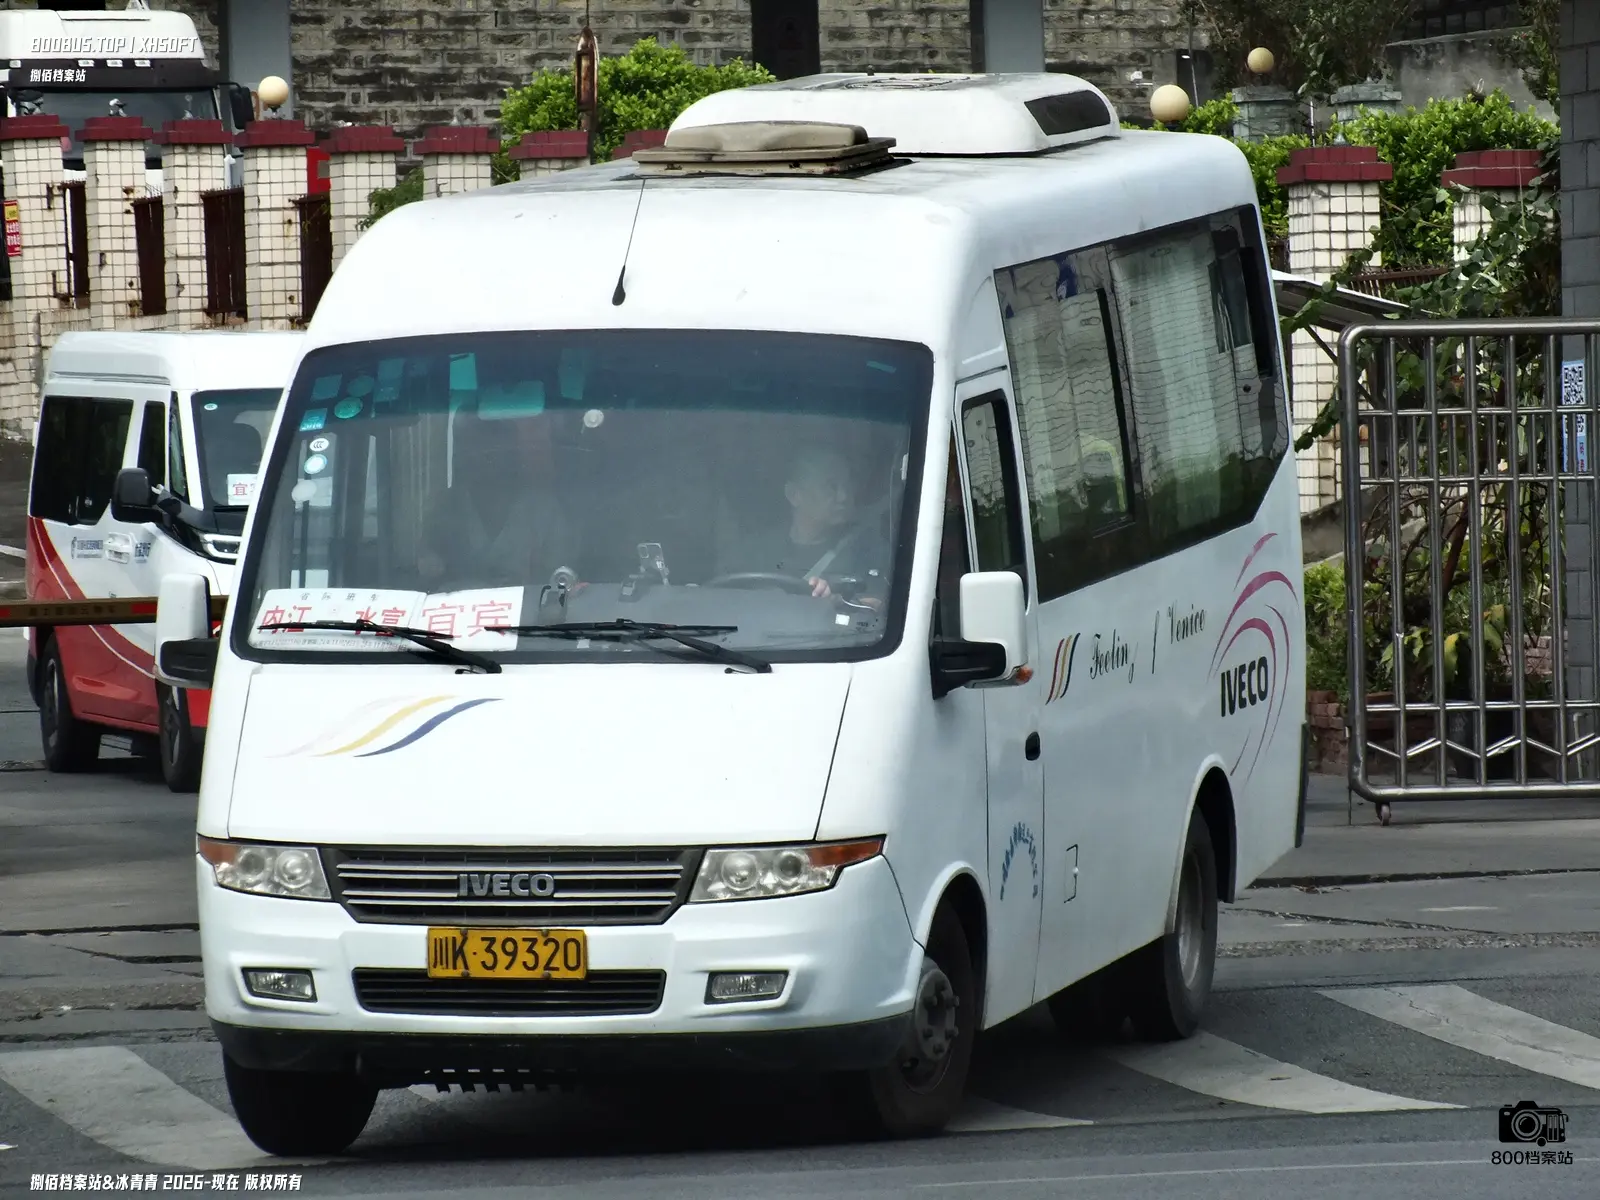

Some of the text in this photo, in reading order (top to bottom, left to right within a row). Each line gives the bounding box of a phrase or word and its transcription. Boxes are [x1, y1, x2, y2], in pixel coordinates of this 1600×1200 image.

[258, 605, 312, 634] 内江
[422, 600, 512, 638] 宜宾
[1221, 656, 1268, 717] IVECO
[459, 873, 554, 897] IVECO
